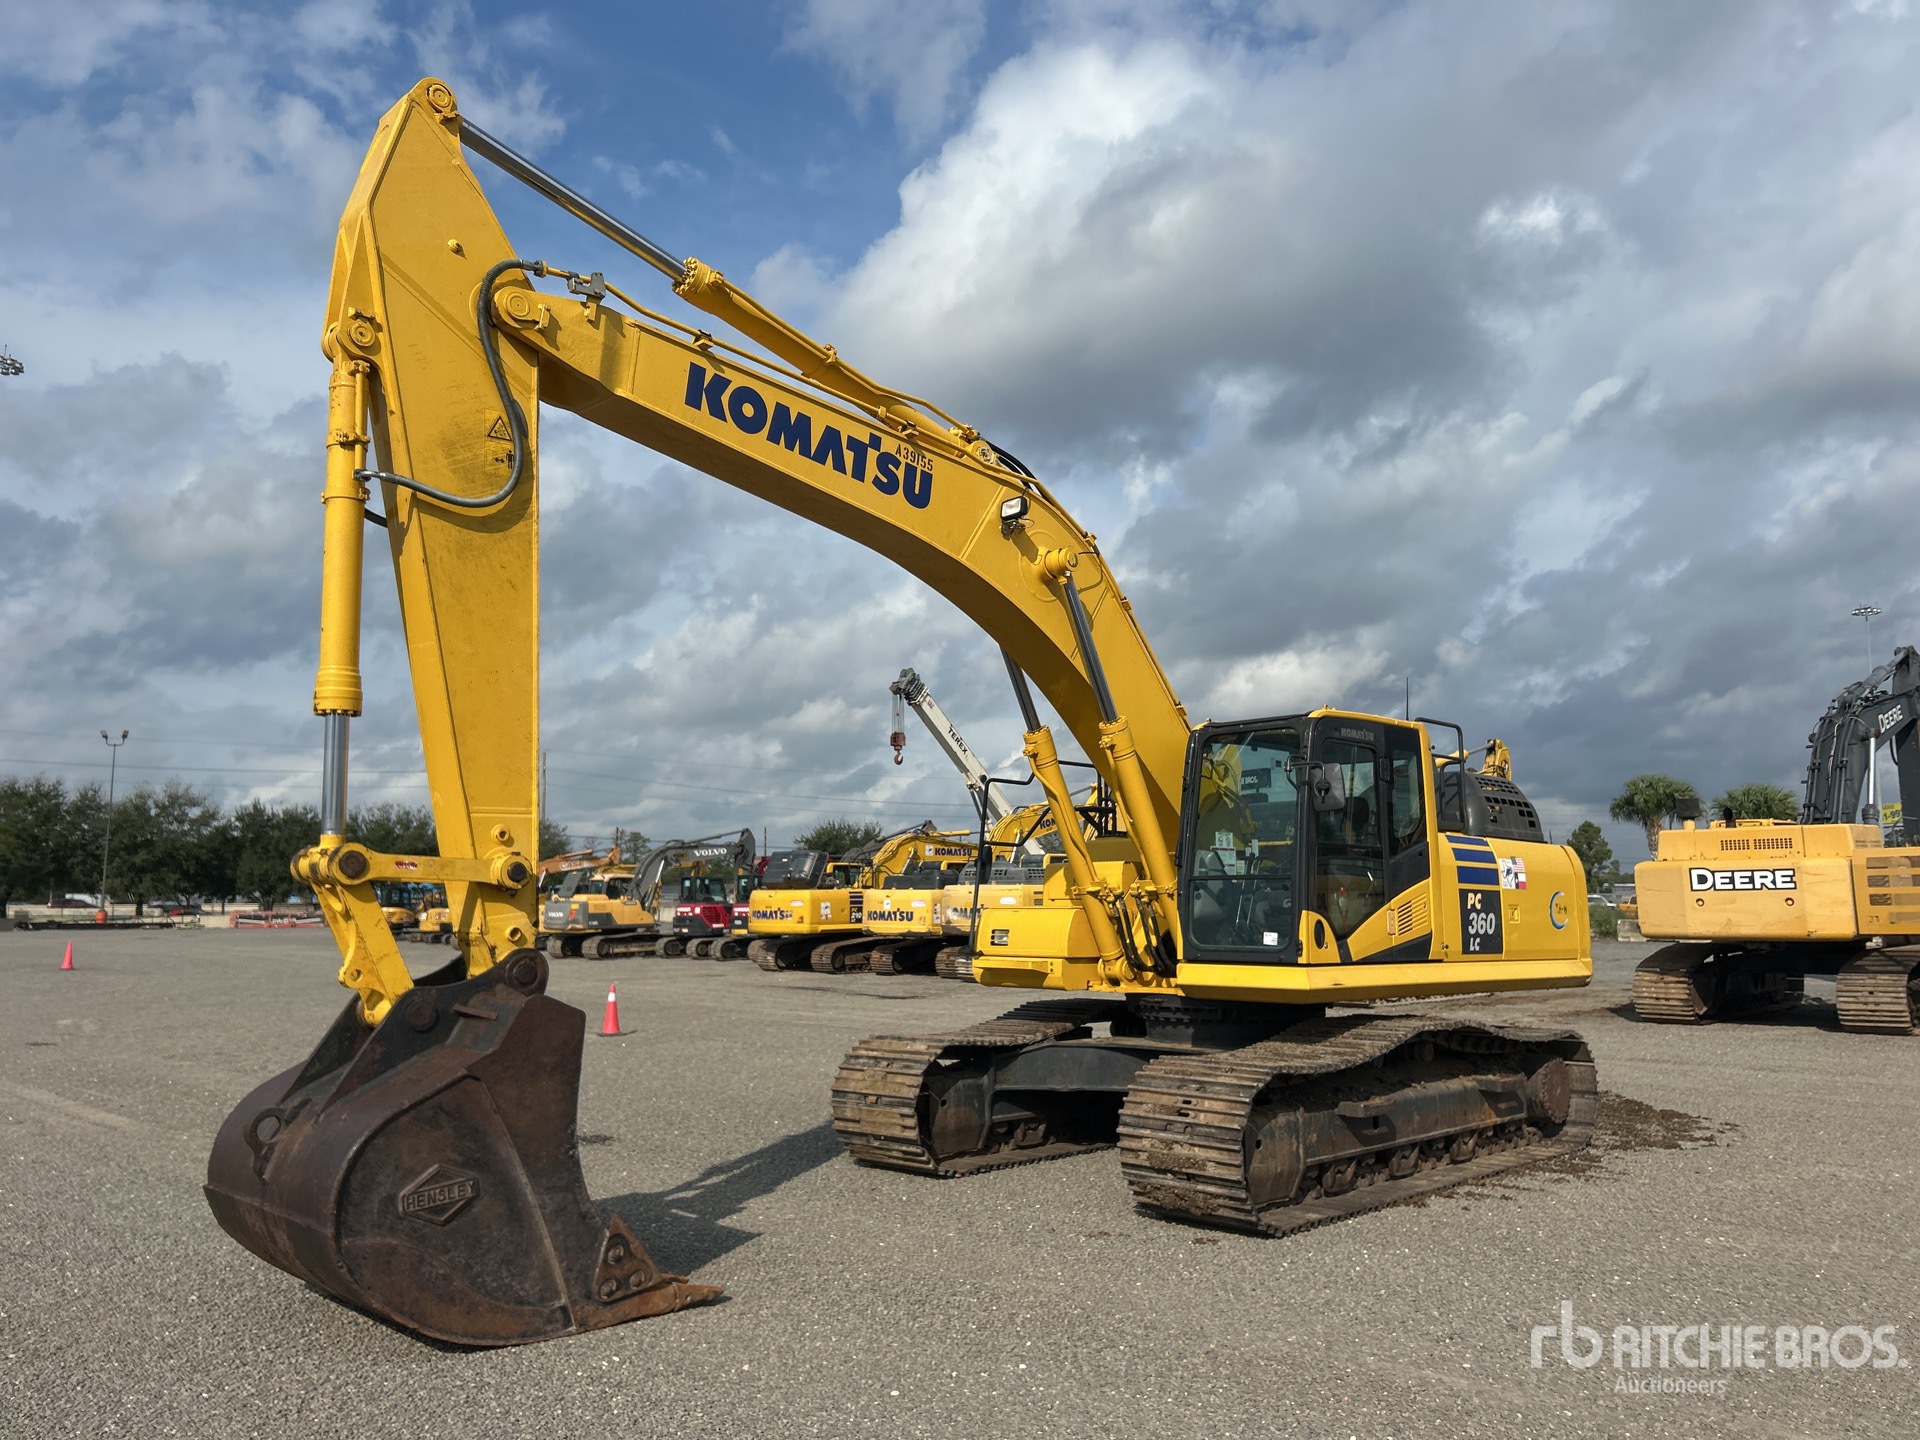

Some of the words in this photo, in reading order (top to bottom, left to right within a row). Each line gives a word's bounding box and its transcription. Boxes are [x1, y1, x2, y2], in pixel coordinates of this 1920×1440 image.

[685, 362, 933, 509] KOMATSU
[895, 444, 934, 472] A39155
[1878, 704, 1903, 733] DEERE
[948, 726, 968, 755] TEREX
[1341, 727, 1374, 741] KOMATSU
[694, 847, 727, 857] VOLVO
[935, 847, 972, 857] KOMATSU
[1690, 869, 1796, 891] DEERE
[1467, 893, 1482, 909] PC
[867, 908, 914, 922] KOMATSU
[1468, 912, 1496, 935] 360
[1469, 937, 1480, 951] LC
[405, 1180, 475, 1211] HENSLEY
